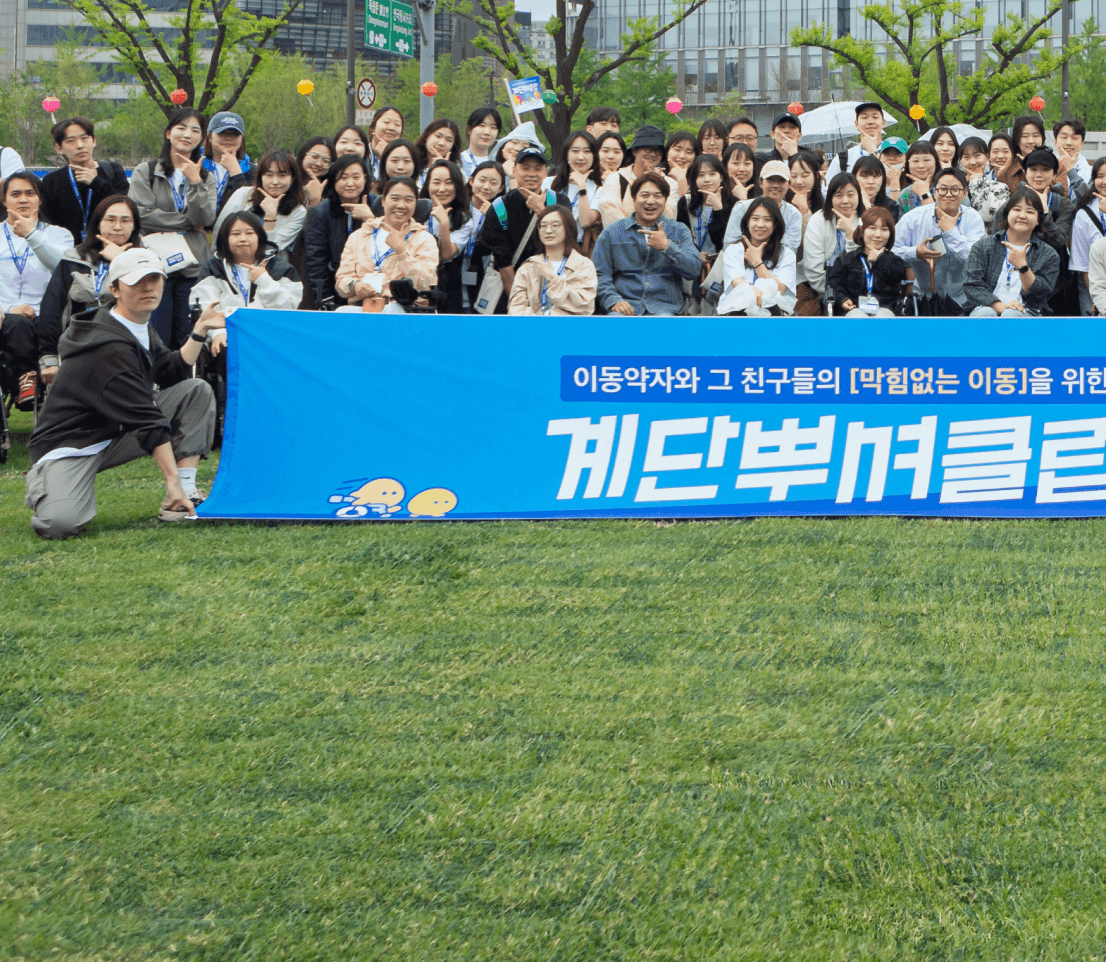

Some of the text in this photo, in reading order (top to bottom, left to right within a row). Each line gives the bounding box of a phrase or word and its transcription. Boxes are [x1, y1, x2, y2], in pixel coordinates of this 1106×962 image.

[574, 366, 700, 393] 이동약자와
[708, 369, 733, 391] 그
[741, 366, 840, 394] 친구들의
[850, 367, 960, 394] [막힘없는
[969, 367, 1053, 394] 이동]을
